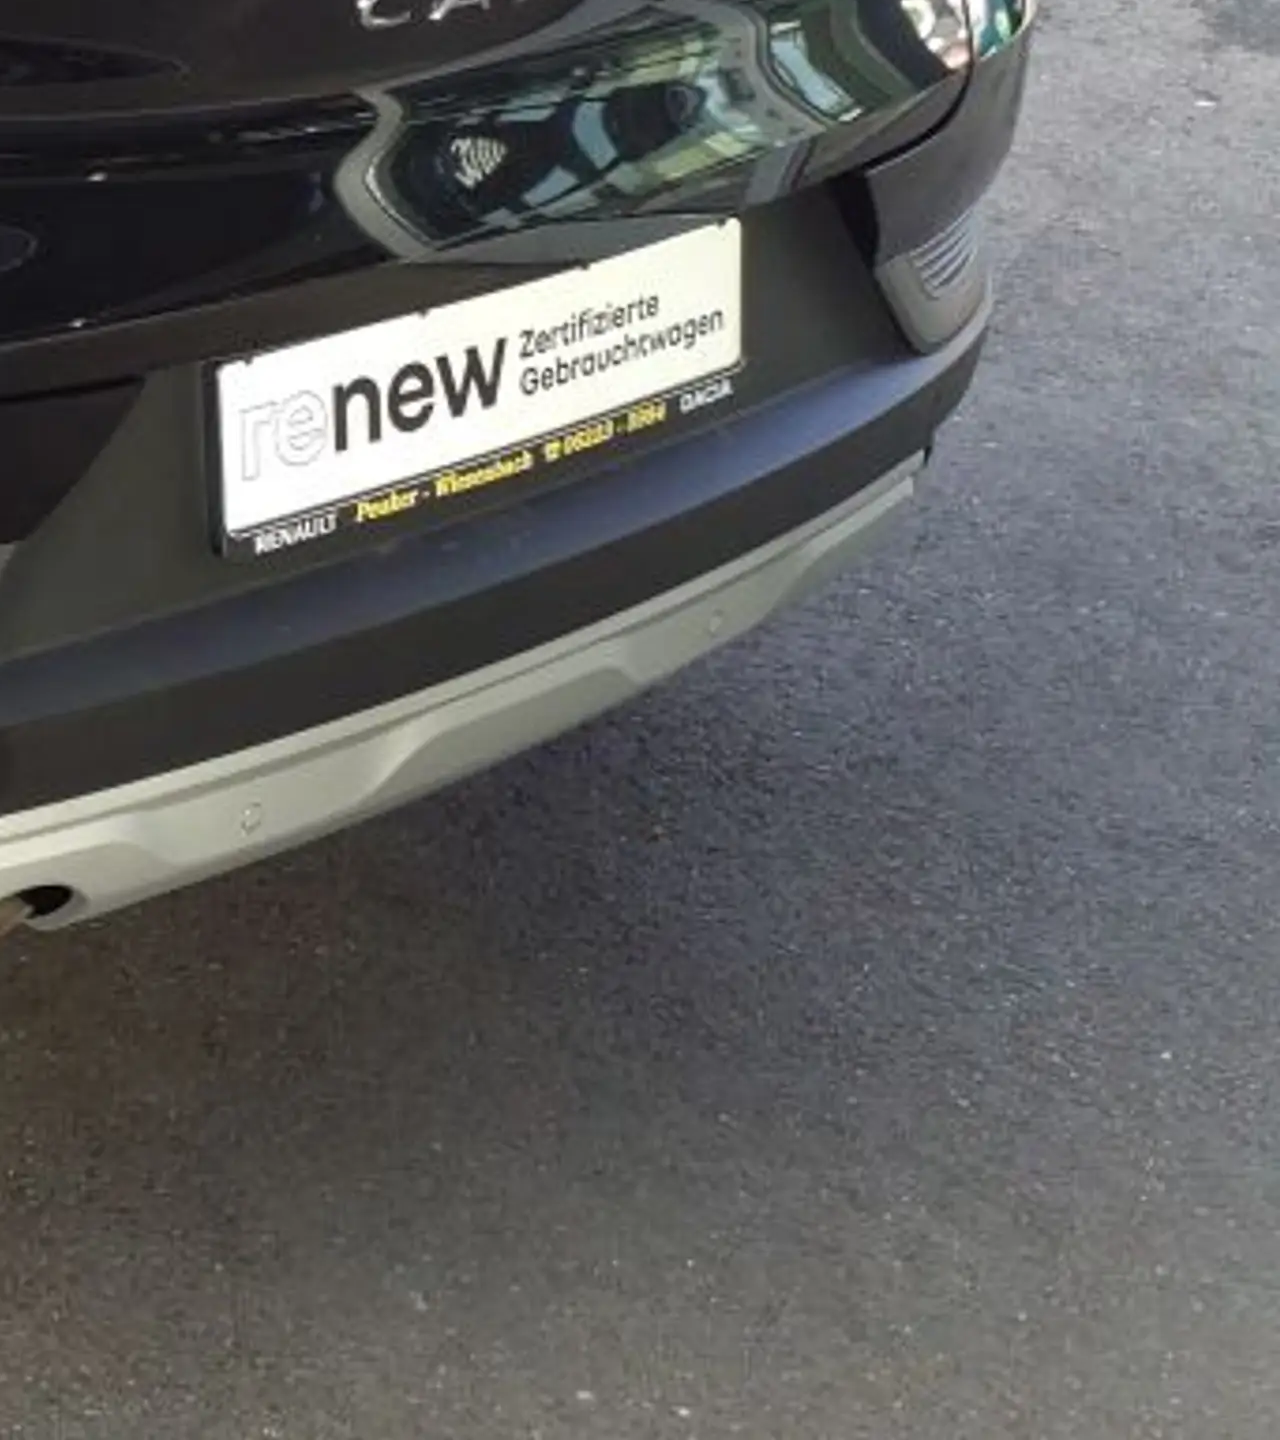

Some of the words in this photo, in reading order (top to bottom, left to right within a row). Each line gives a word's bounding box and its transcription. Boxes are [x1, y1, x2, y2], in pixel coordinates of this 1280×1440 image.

[518, 294, 660, 358] Zertifizierte
[518, 308, 725, 394] Gebrauchtwagen
[240, 338, 507, 481] renew
[254, 514, 338, 555] RENAULT
